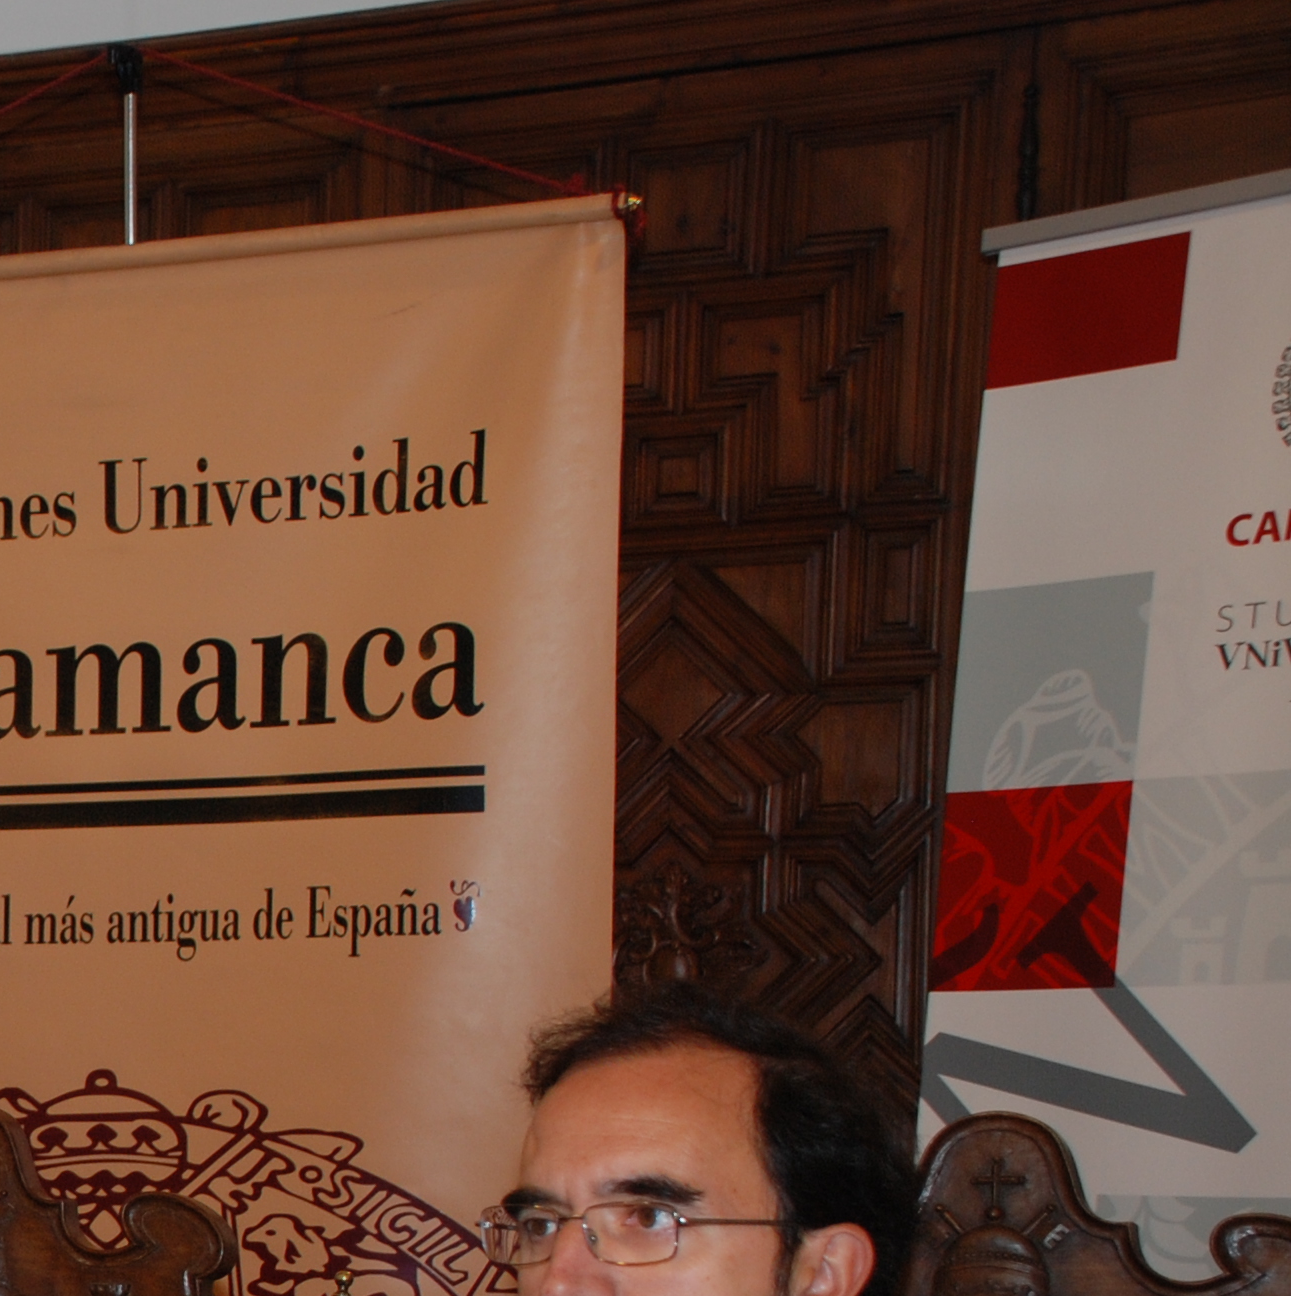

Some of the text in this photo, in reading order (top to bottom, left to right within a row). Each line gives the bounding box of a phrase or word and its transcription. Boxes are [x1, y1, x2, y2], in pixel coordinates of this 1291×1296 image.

[99, 429, 488, 535] Universidad
[24, 895, 94, 945] más
[106, 893, 241, 962] antigua
[253, 887, 294, 941] de
[306, 885, 441, 957] España
